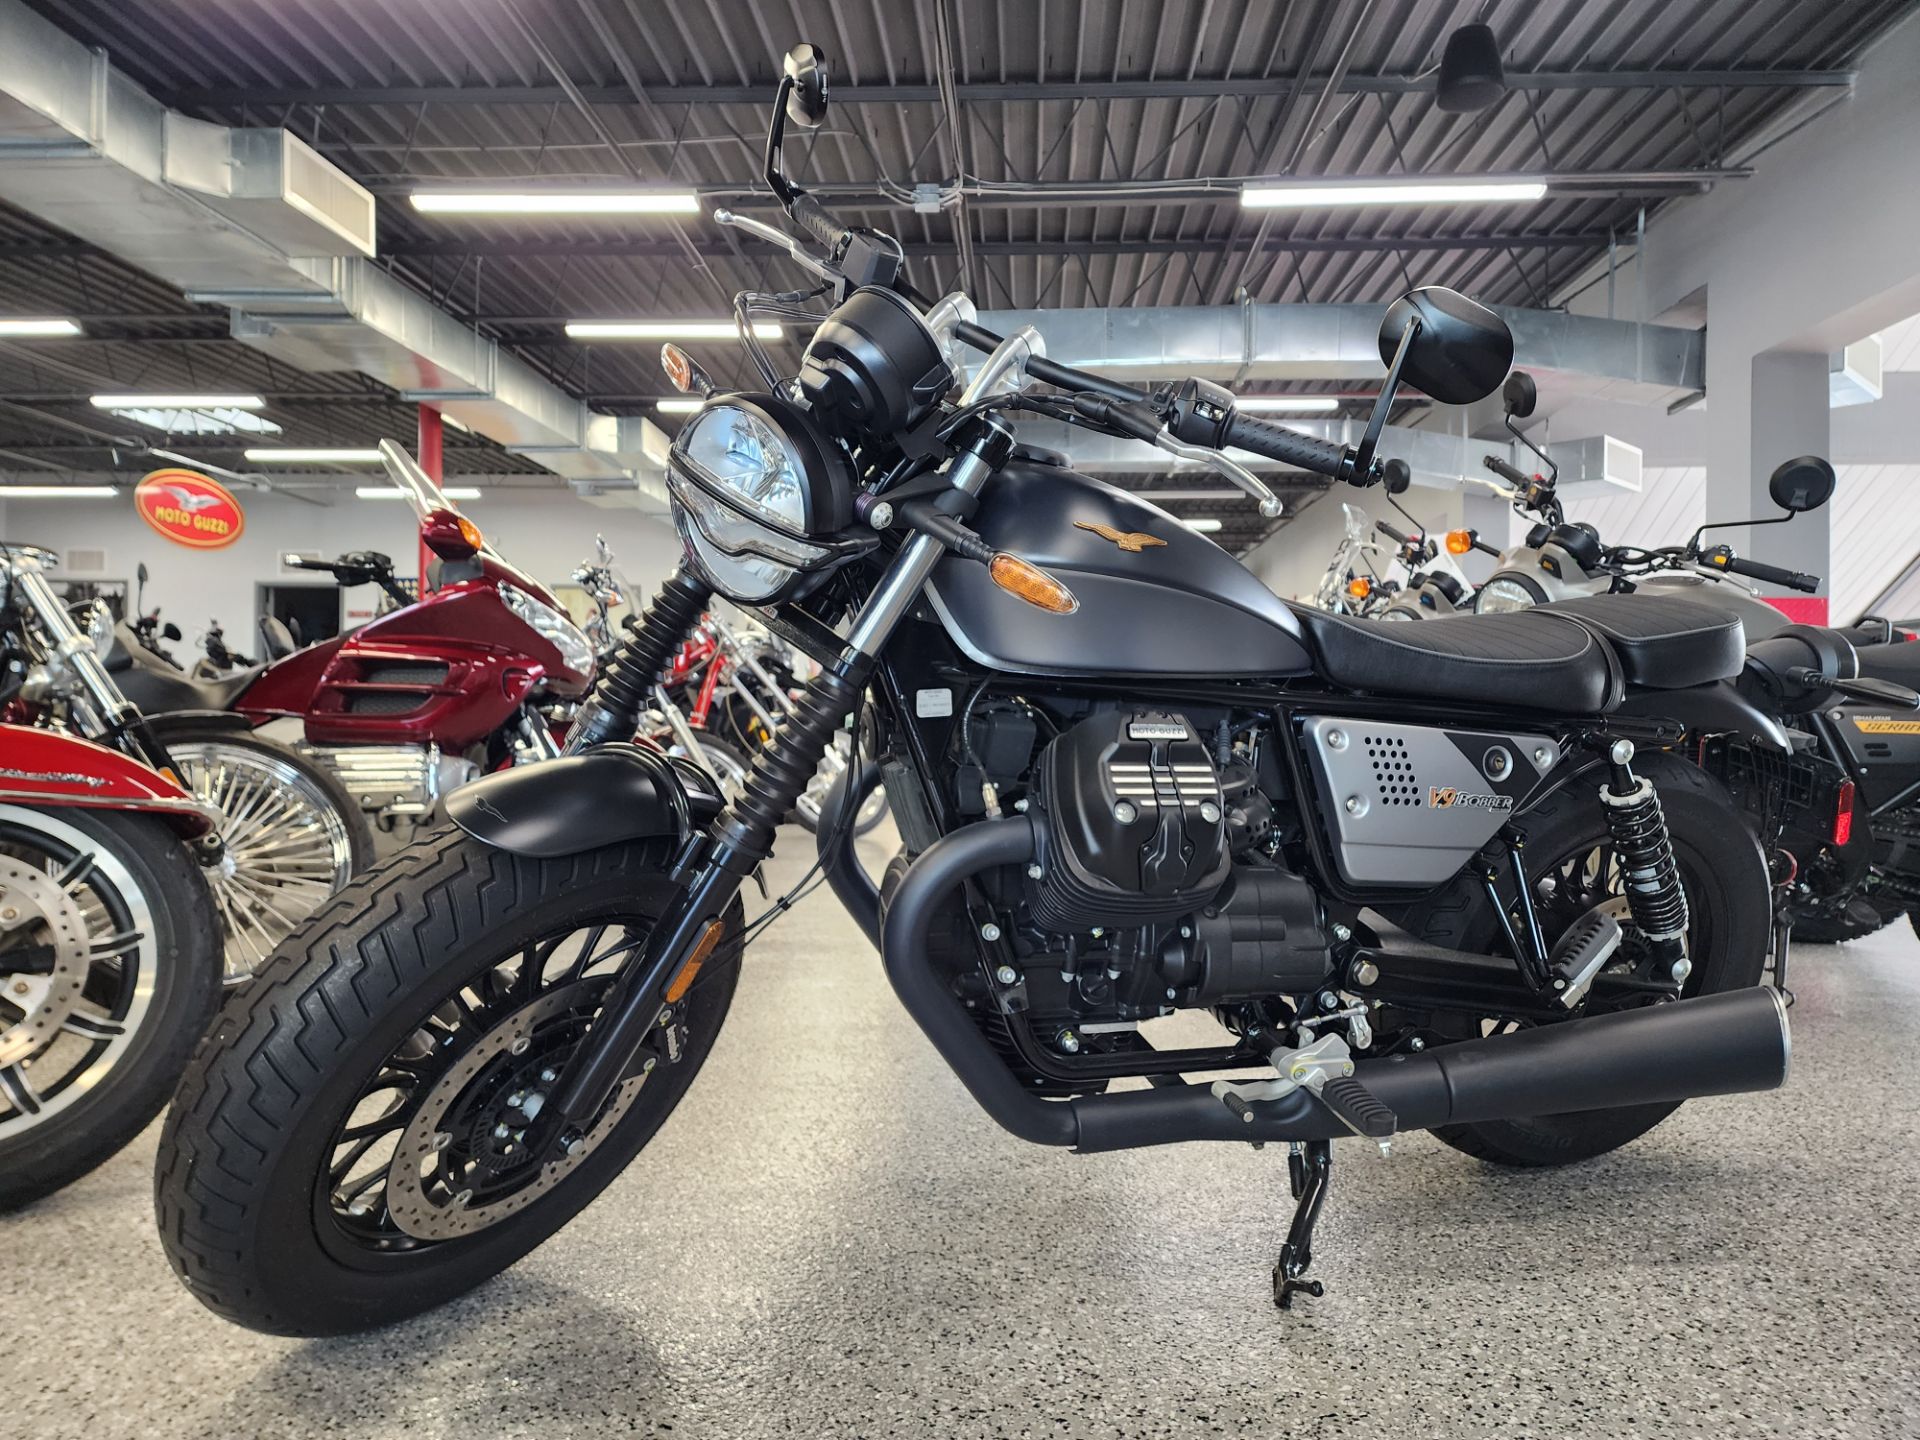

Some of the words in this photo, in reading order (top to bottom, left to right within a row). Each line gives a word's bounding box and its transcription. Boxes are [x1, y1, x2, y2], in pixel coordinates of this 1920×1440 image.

[155, 505, 192, 527] MOTO
[193, 514, 230, 535] GUZZI
[1132, 727, 1156, 735] MOTO
[1158, 727, 1185, 735] GUZZI
[1428, 786, 1457, 808] V9
